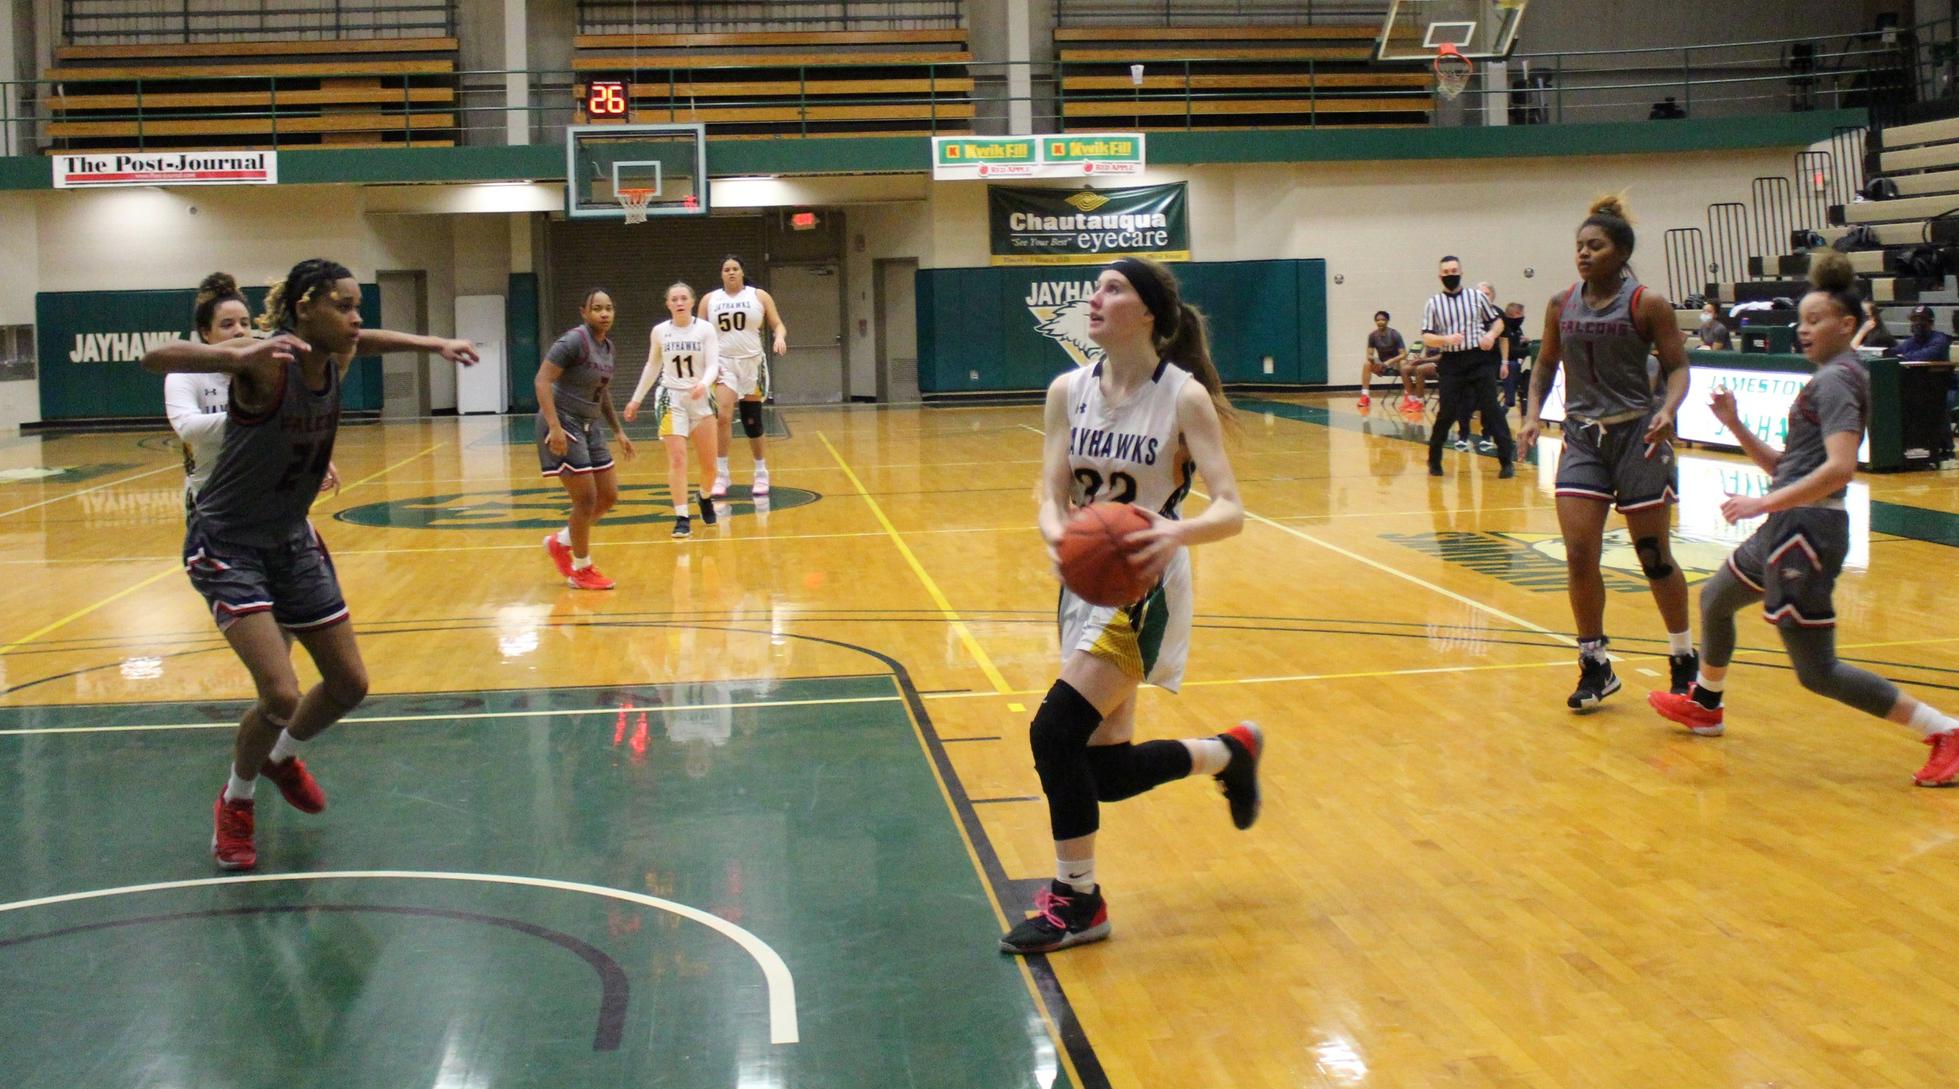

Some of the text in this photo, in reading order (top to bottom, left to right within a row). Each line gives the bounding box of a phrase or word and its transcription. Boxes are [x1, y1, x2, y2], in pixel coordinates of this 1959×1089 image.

[590, 85, 625, 113] 26
[63, 153, 265, 173] The Post-Journal
[1009, 211, 1167, 233] Chautauqua
[1030, 237, 1049, 247] Your
[1077, 229, 1168, 252] eyecare
[1026, 280, 1100, 305] JAYHA
[714, 301, 751, 312] JAYHAWKS
[717, 311, 746, 332] 50
[664, 341, 702, 352] JAYHAWKS
[672, 354, 695, 379] 11
